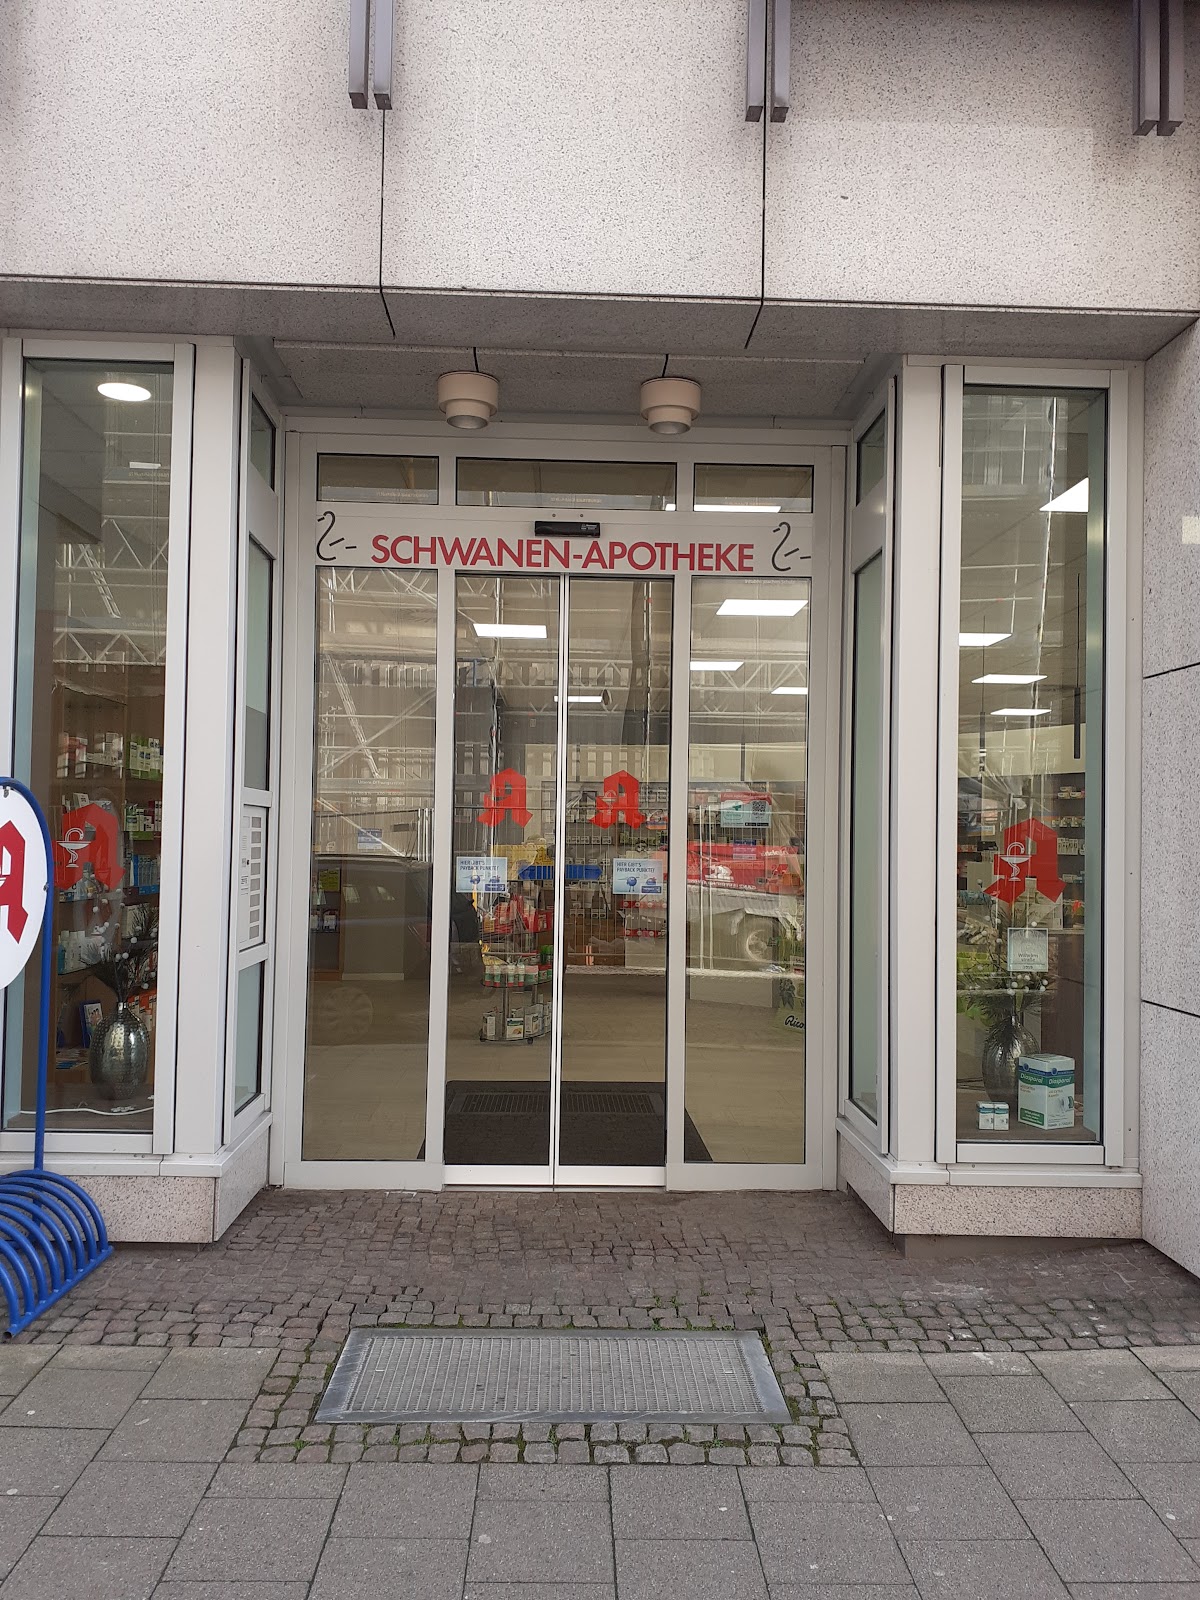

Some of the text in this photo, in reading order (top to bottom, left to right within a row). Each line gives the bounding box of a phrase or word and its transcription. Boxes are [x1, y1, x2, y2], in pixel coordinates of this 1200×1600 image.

[371, 534, 754, 571] SCHWANEN-APOTHEKE
[1020, 1072, 1043, 1083] Diasporal
[1048, 1076, 1072, 1085] Diasporal
